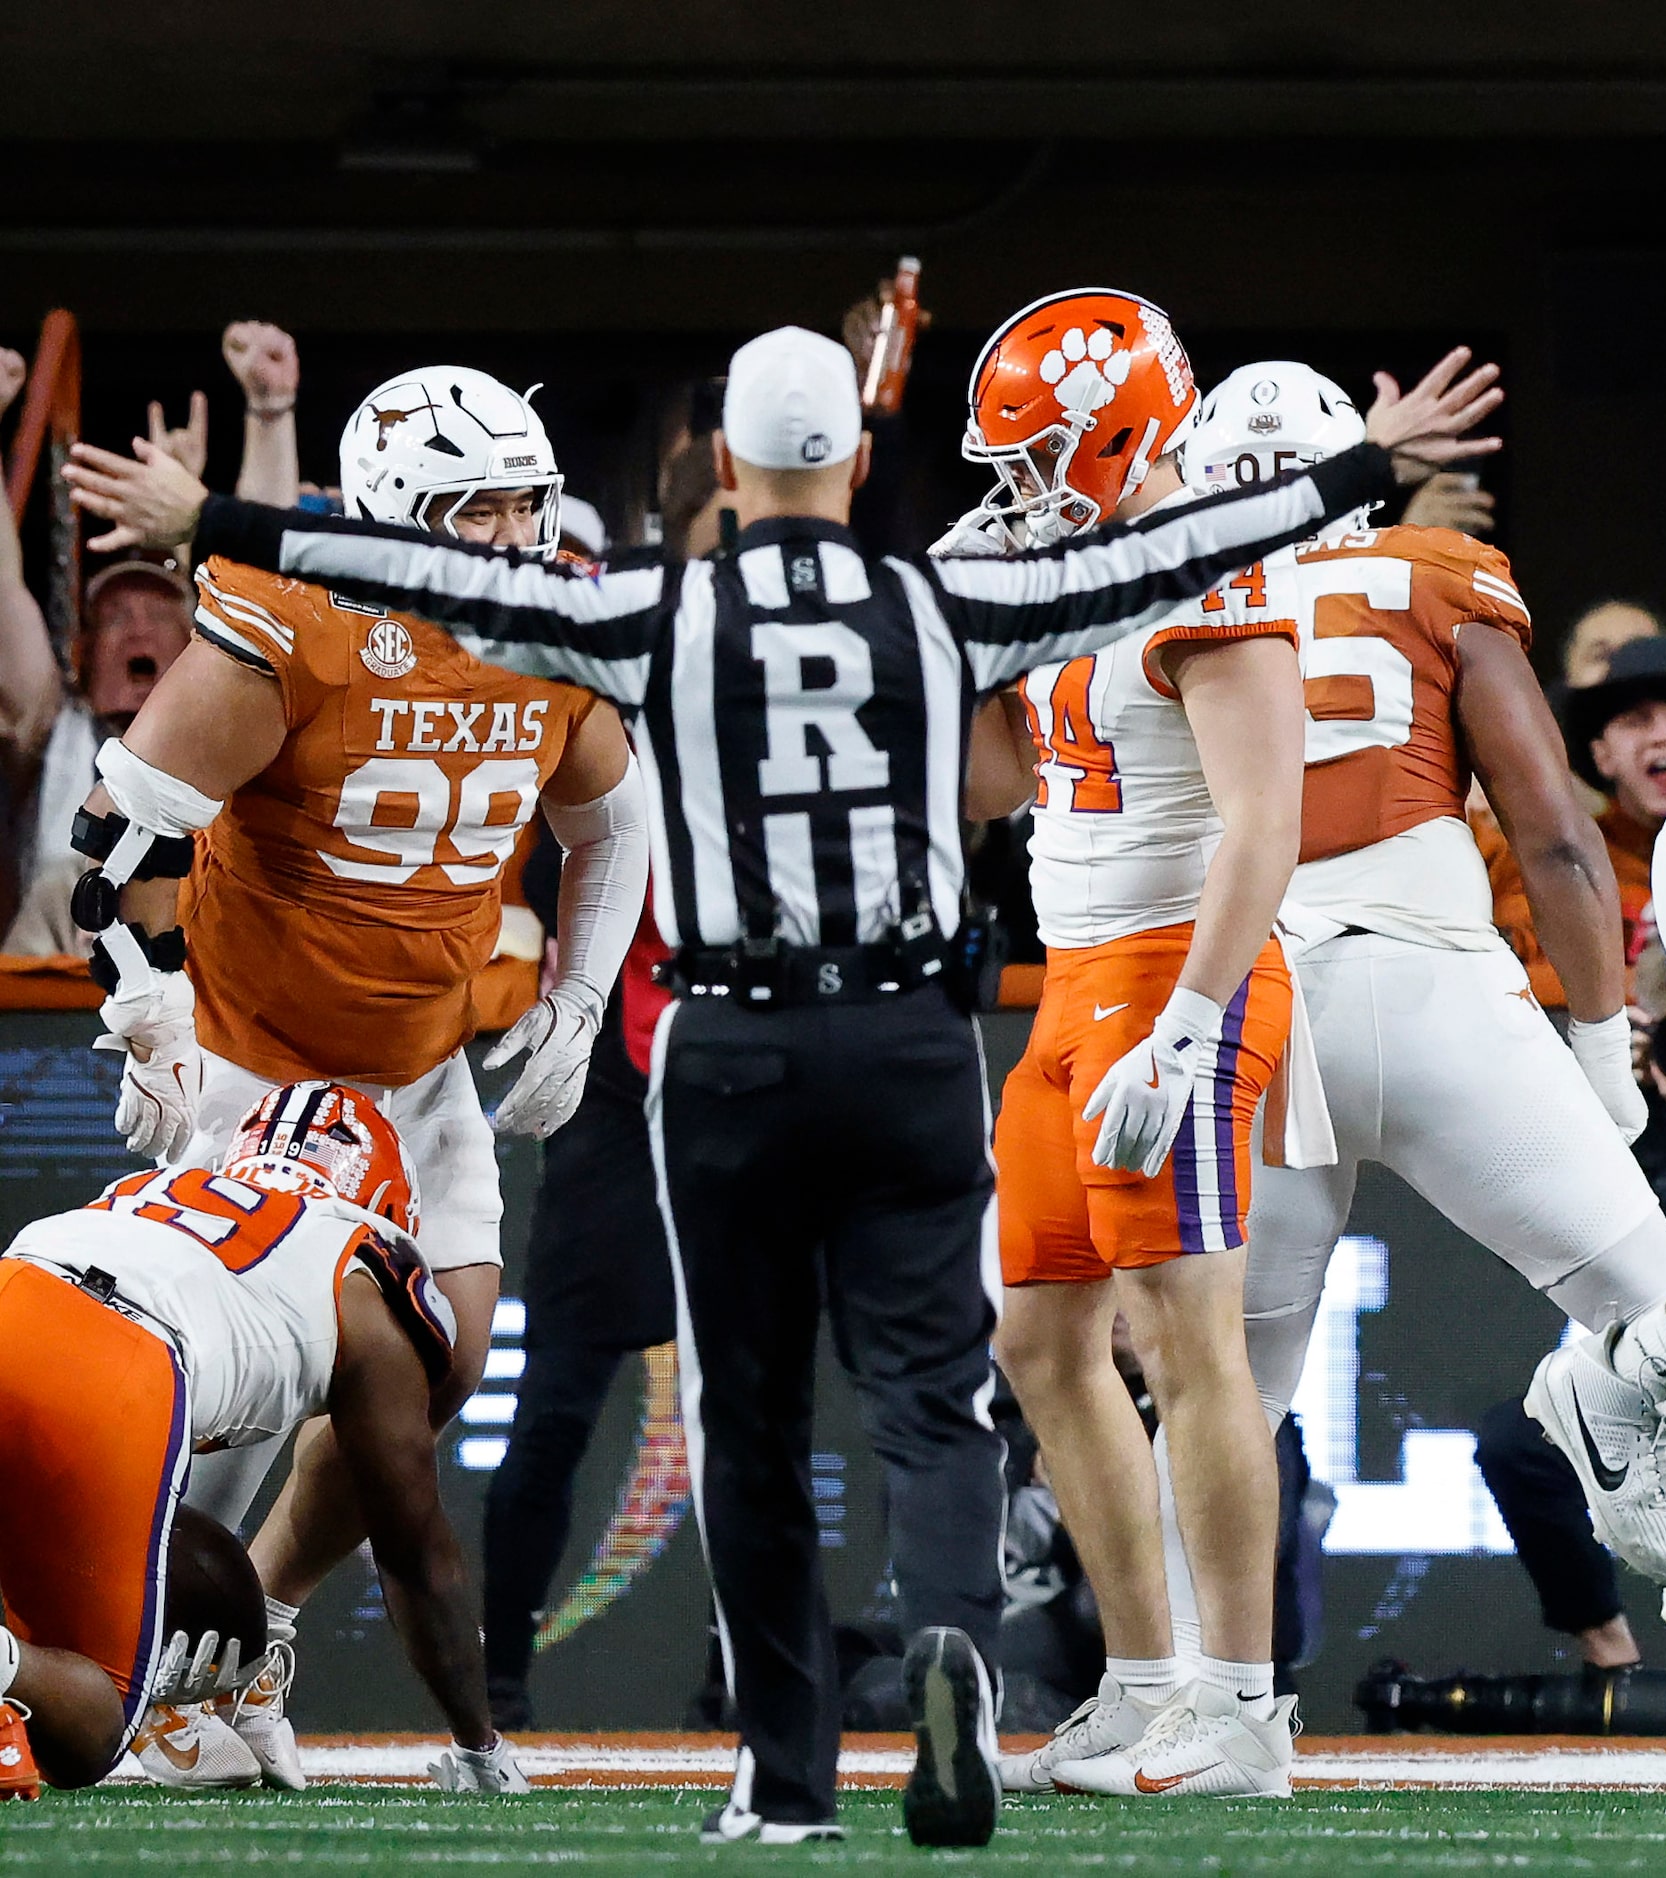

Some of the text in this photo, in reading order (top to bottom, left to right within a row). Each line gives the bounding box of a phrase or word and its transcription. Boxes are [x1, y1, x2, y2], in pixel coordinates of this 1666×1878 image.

[364, 656, 411, 678] GRADUATE
[373, 623, 408, 664] SEC
[370, 697, 549, 752] TEXAS
[751, 620, 890, 797] R
[316, 757, 542, 886] 99
